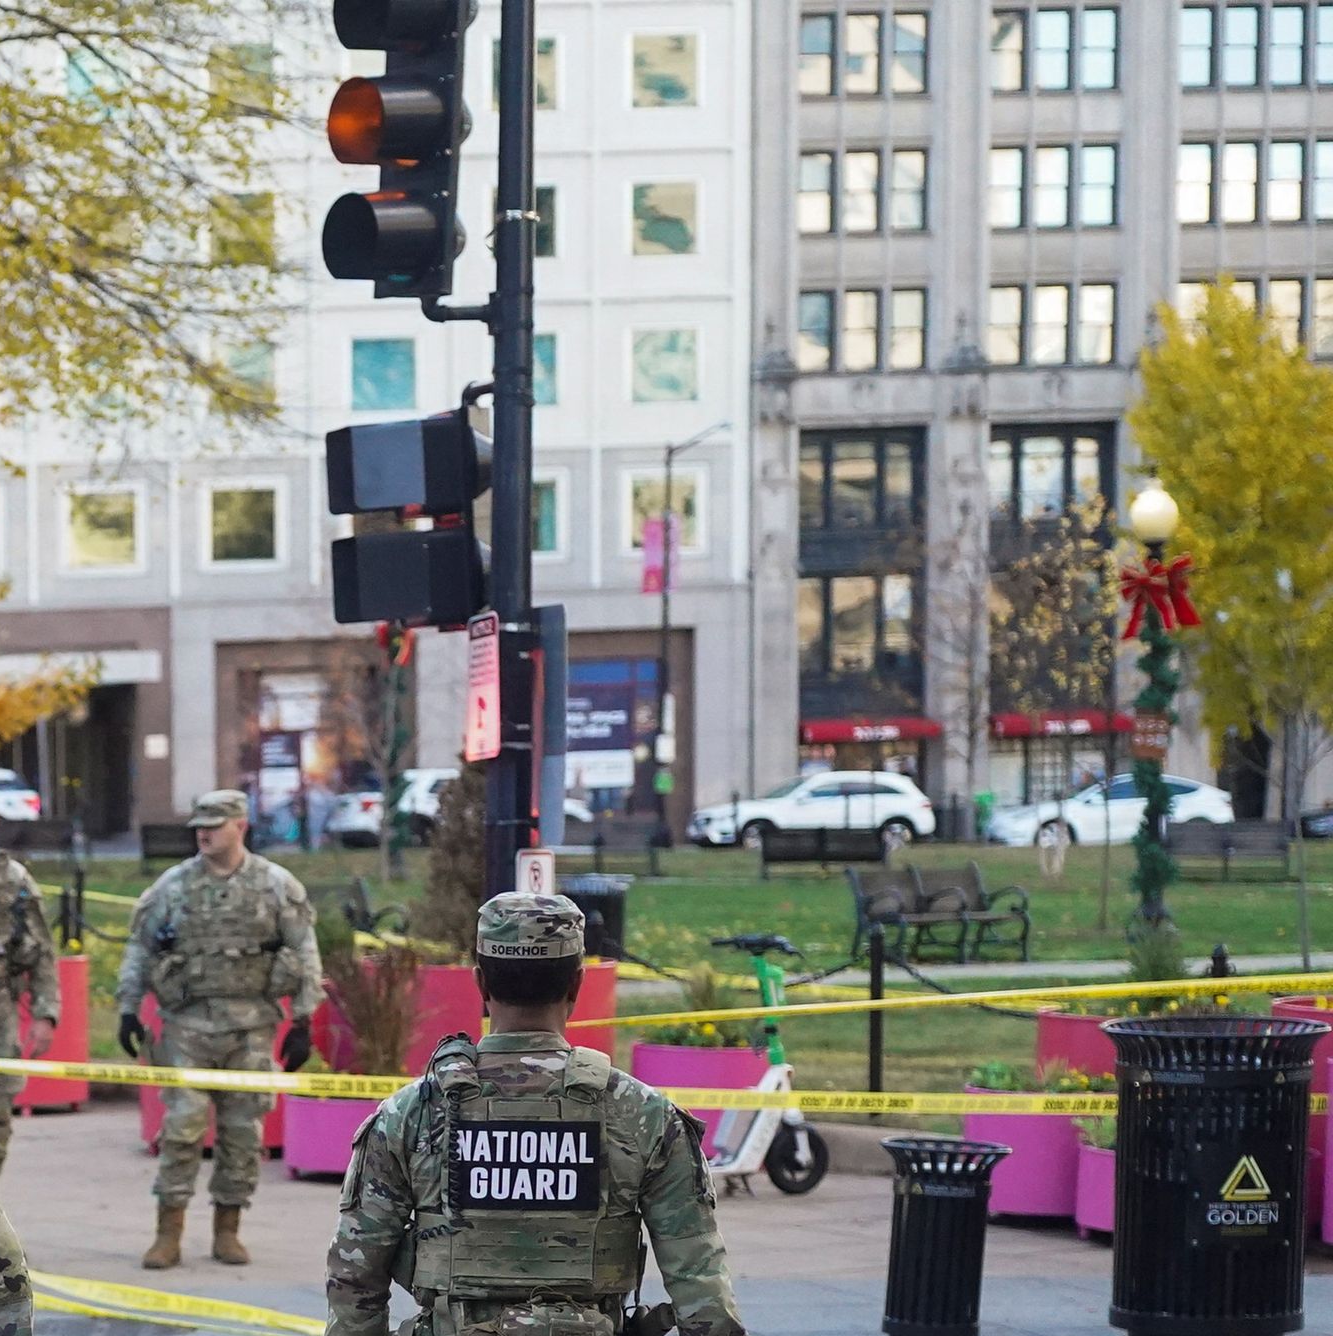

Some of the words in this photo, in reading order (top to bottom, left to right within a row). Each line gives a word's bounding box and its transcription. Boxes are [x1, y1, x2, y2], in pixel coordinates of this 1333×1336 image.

[491, 944, 548, 956] SOEKHOE
[457, 1131, 594, 1164] NATIONAL
[469, 1167, 577, 1200] GUARD
[1207, 1209, 1279, 1225] GOLDEN
